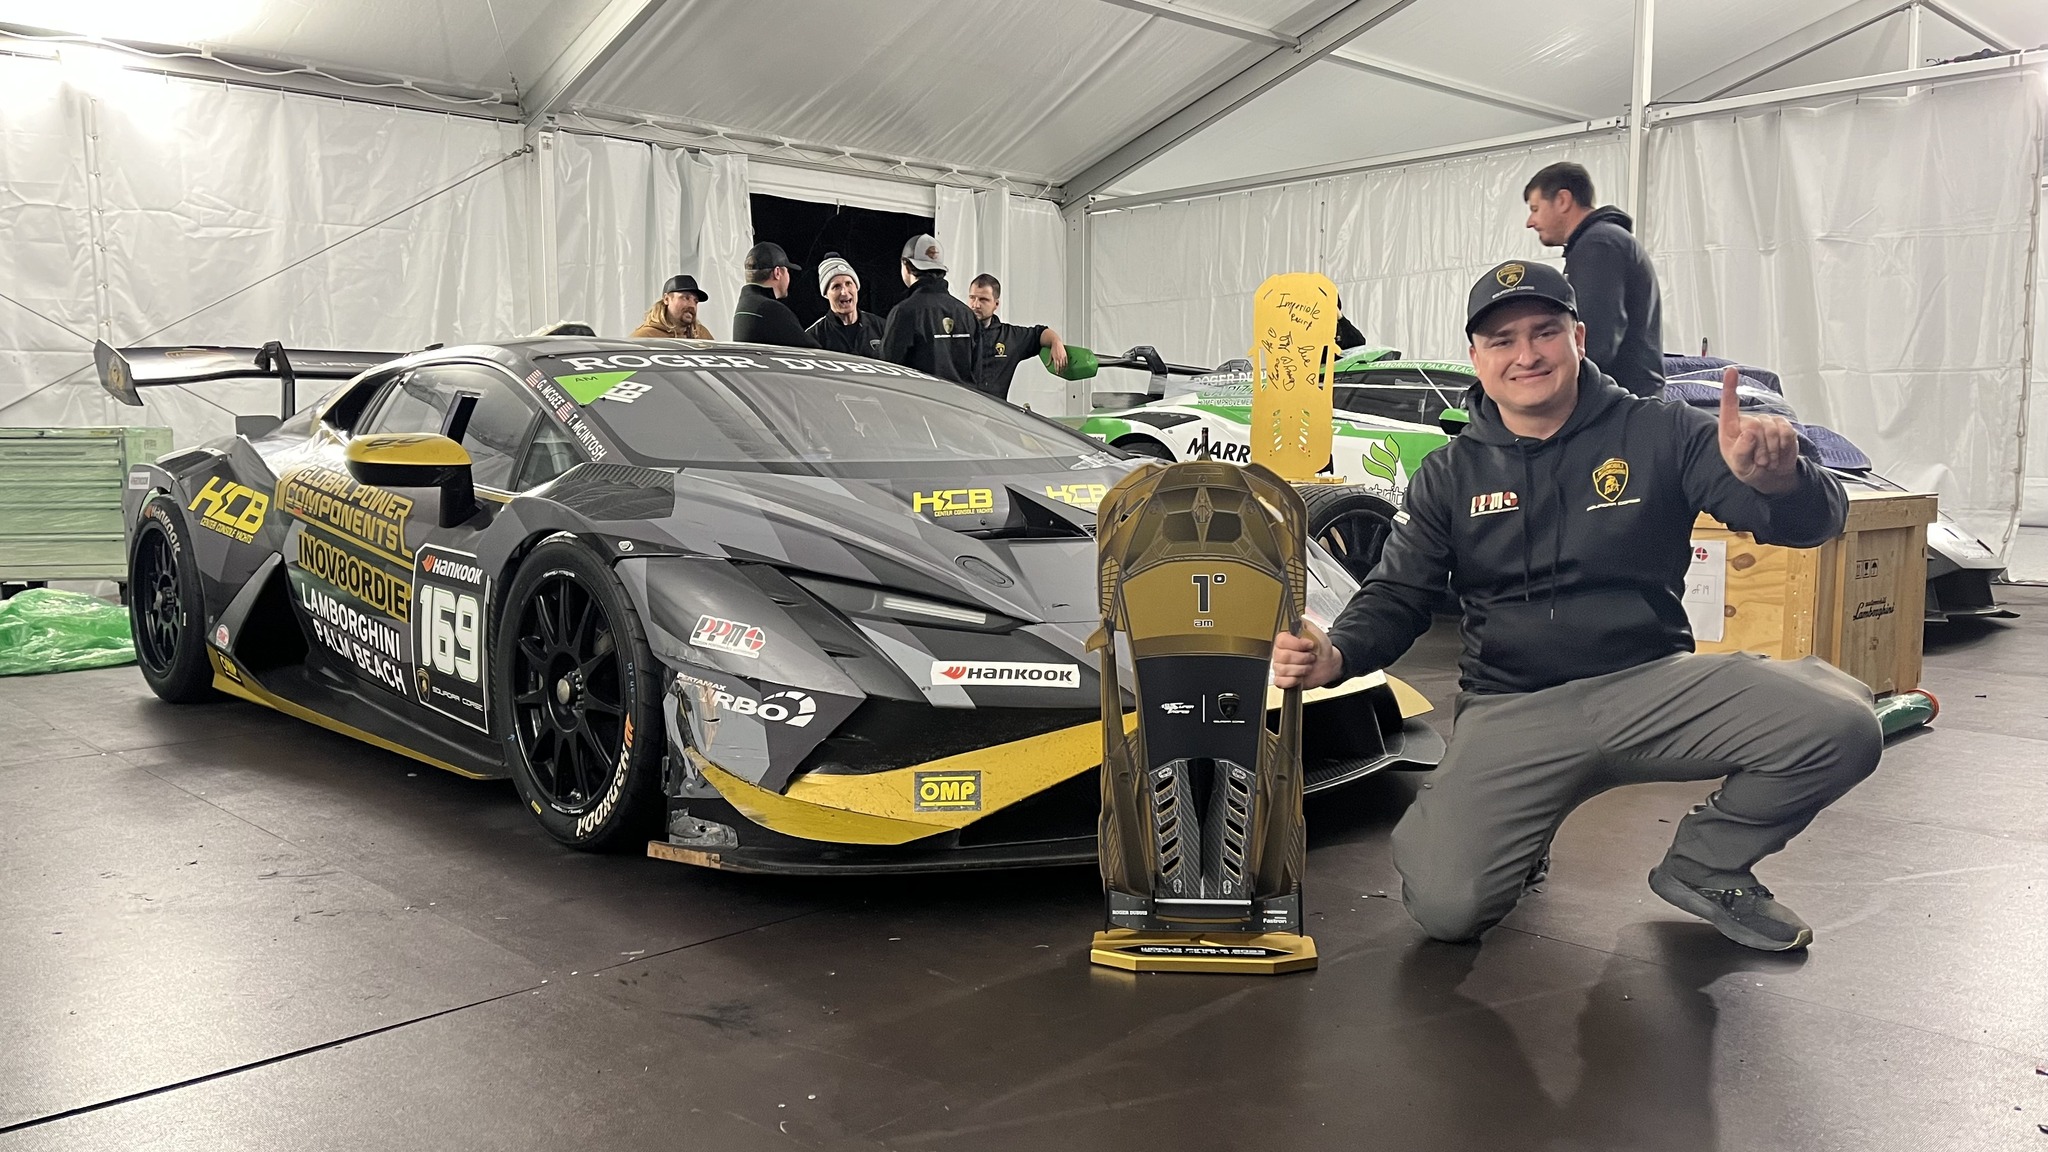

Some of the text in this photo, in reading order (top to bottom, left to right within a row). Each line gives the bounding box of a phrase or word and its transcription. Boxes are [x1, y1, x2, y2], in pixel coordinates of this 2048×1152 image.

[561, 354, 769, 371] ROGER
[1368, 361, 1423, 369] LAMBORGHINI
[1424, 362, 1449, 371] PALM
[541, 384, 566, 410] MCGEE
[571, 419, 608, 461] MCINTOSH
[295, 465, 414, 521] GLOBAL POWER
[285, 481, 400, 552] COMPONENTS
[301, 582, 401, 662] LAMBORGHINI
[419, 584, 480, 684] 169
[1193, 618, 1214, 628] am
[312, 618, 408, 696] PALM BEACH
[676, 671, 727, 692] PERTAMAX
[919, 781, 977, 801] OMP
